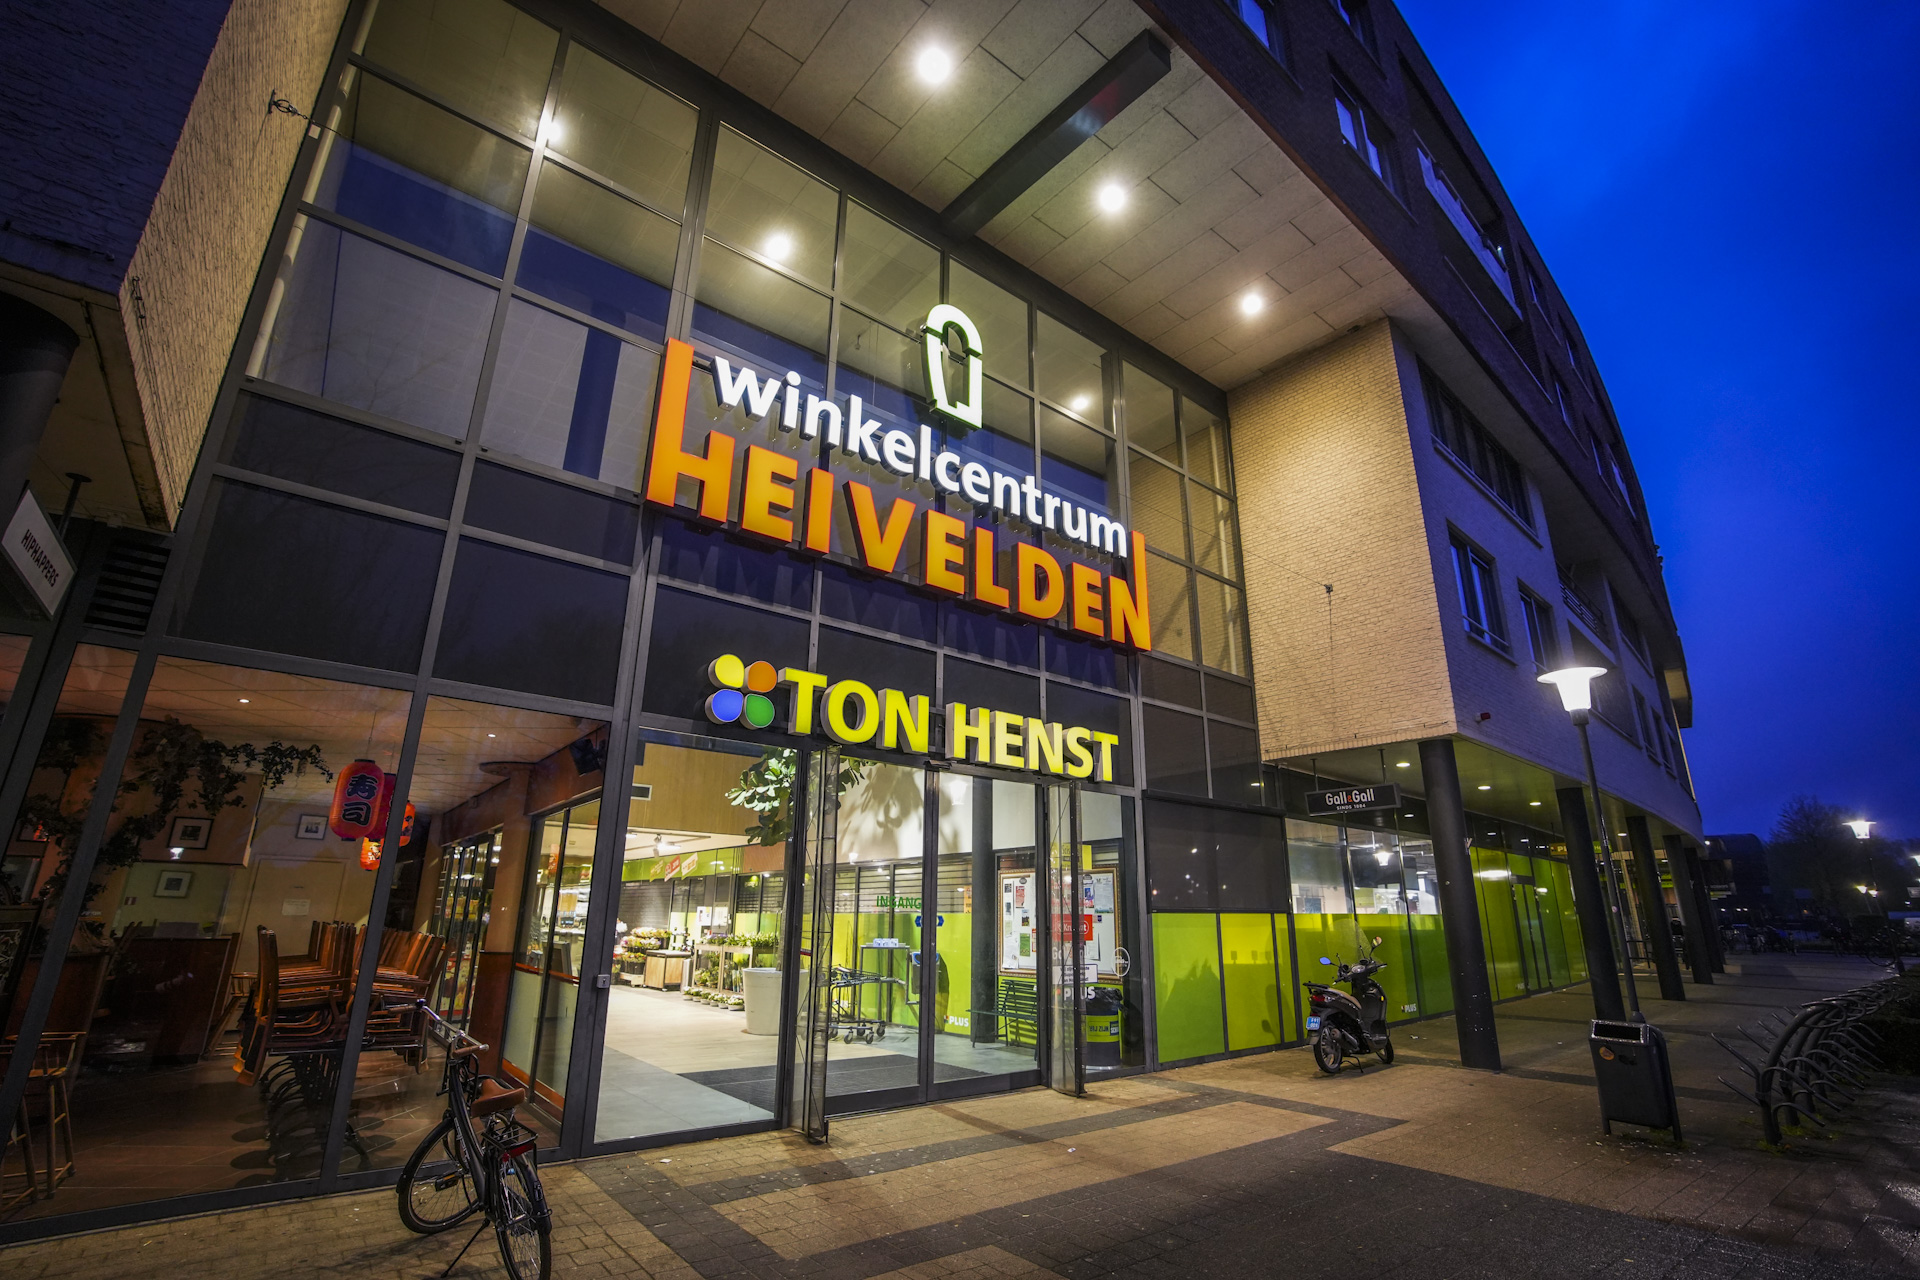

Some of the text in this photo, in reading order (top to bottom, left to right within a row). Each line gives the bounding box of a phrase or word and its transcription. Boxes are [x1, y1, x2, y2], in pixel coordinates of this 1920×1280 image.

[710, 355, 1128, 559] winkelcentrum
[646, 338, 1152, 652] HEIVELDEN
[21, 529, 60, 587] HIPHAPPERS
[777, 667, 1119, 783] TON HENST
[876, 895, 922, 909] INGANG
[949, 1015, 969, 1027] PLUS
[1404, 1003, 1417, 1013] PLUS
